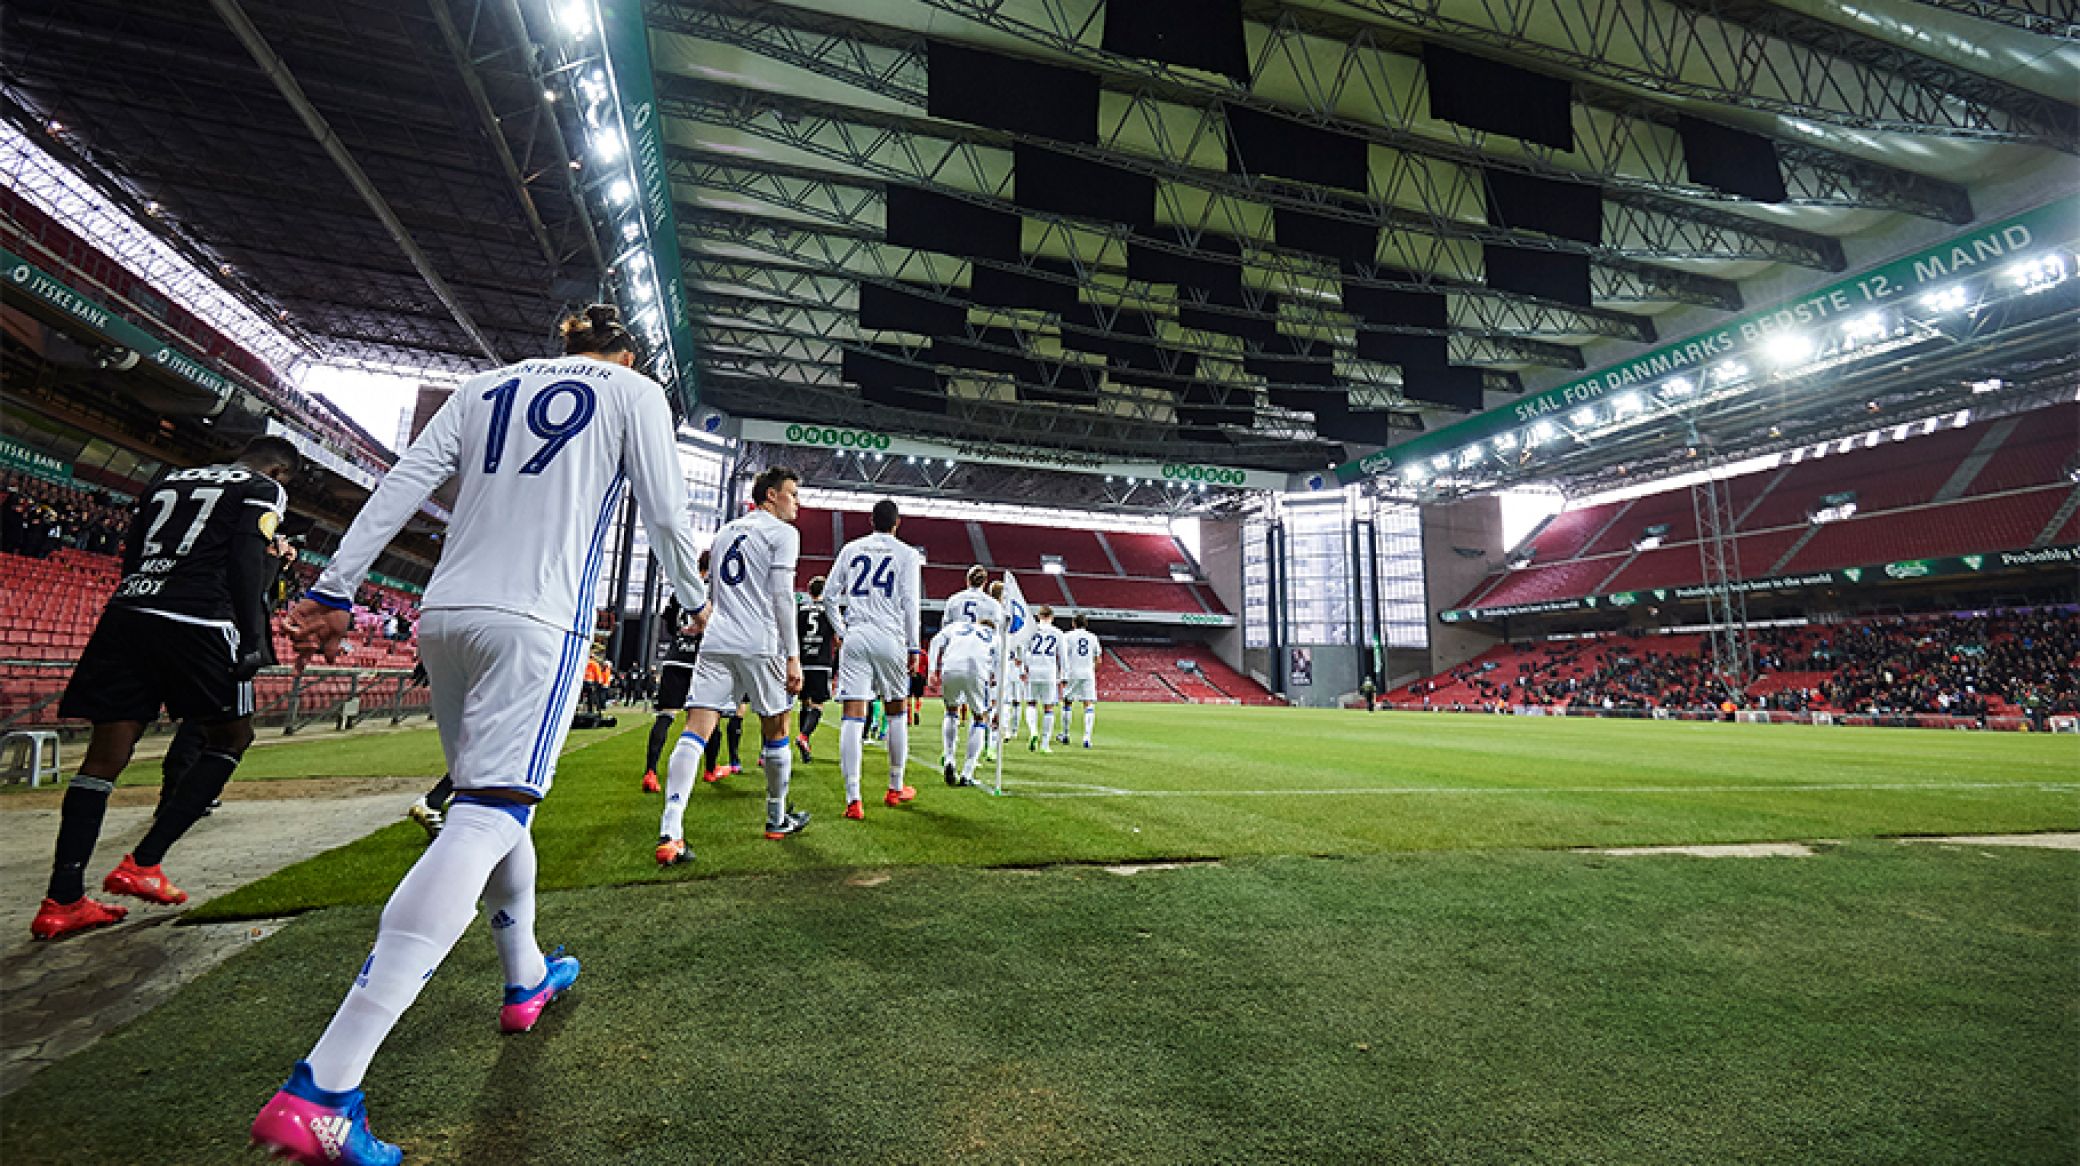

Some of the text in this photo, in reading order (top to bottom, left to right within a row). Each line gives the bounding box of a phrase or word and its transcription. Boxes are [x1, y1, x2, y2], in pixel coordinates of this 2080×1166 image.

[1563, 378, 1603, 405] FOR
[1606, 331, 1735, 389] DANMARKS
[1858, 275, 1905, 301] 12.
[1912, 224, 2033, 284] MAND
[482, 377, 597, 475] 19
[142, 487, 225, 557] 27
[720, 534, 747, 586] 6
[850, 554, 895, 598] 24
[806, 612, 819, 637] 5
[963, 600, 977, 623] 5
[1031, 633, 1057, 656] 22
[1078, 637, 1089, 657] 8
